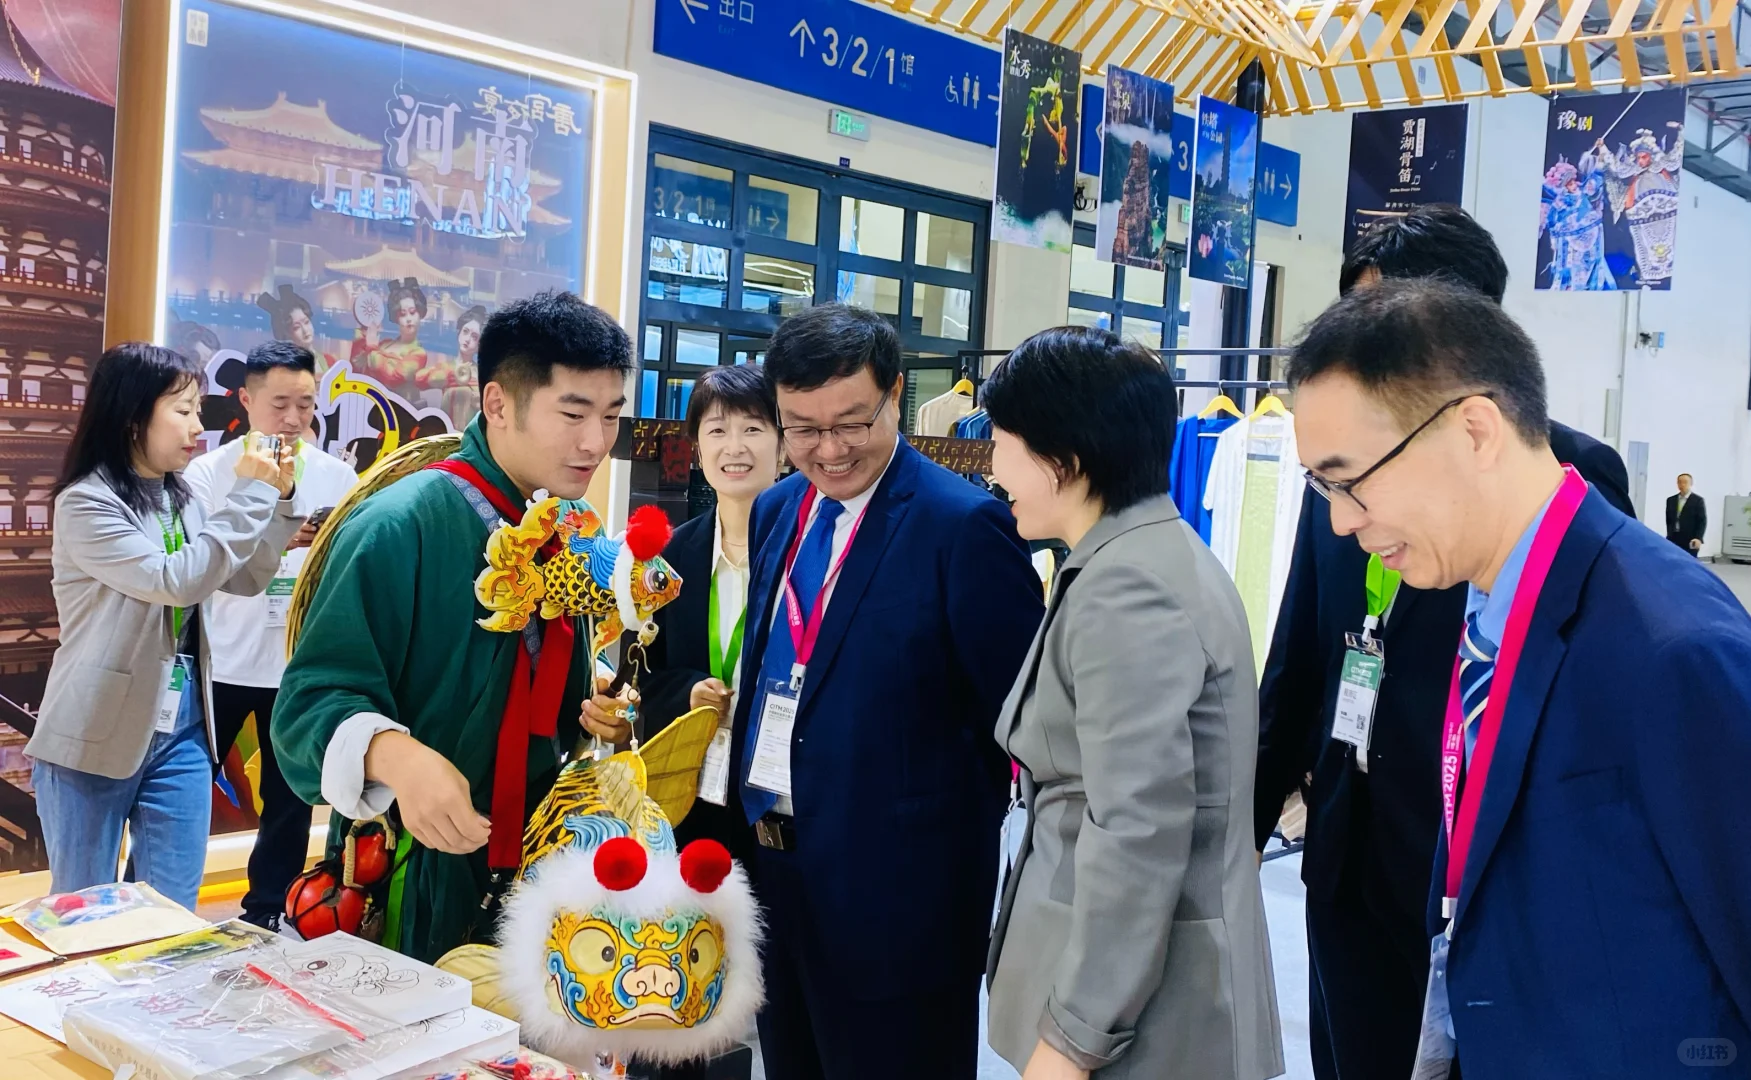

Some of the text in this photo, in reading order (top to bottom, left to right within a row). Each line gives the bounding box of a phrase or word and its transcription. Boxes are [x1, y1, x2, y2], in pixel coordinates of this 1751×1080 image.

[719, 0, 754, 24] 出口
[393, 94, 533, 188] 河南
[1398, 119, 1416, 183] 贾湖骨笛
[1557, 110, 1593, 131] 豫剧
[320, 163, 528, 237] HENAN
